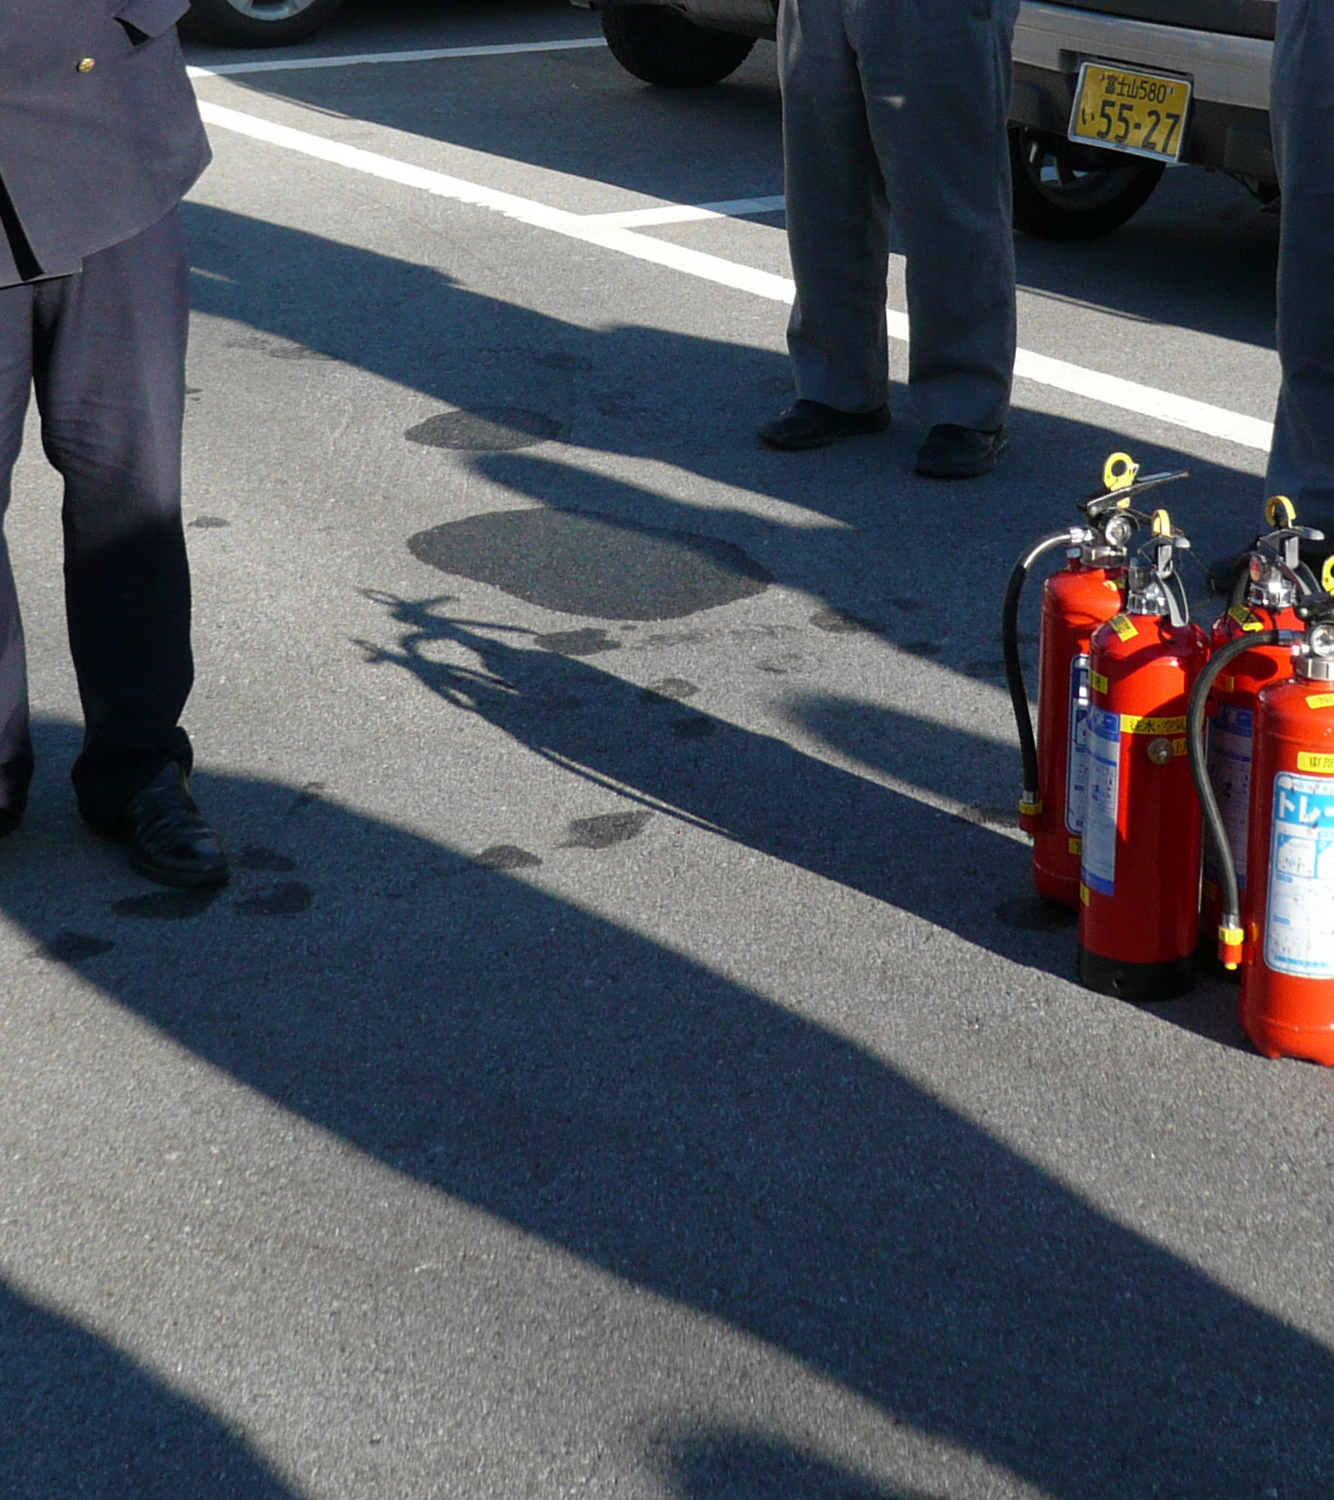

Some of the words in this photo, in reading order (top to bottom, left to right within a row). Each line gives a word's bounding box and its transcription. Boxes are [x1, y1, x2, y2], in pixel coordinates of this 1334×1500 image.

[1103, 74, 1167, 104] 富士山580
[1082, 107, 1095, 126] い
[1096, 100, 1180, 152] 55-27
